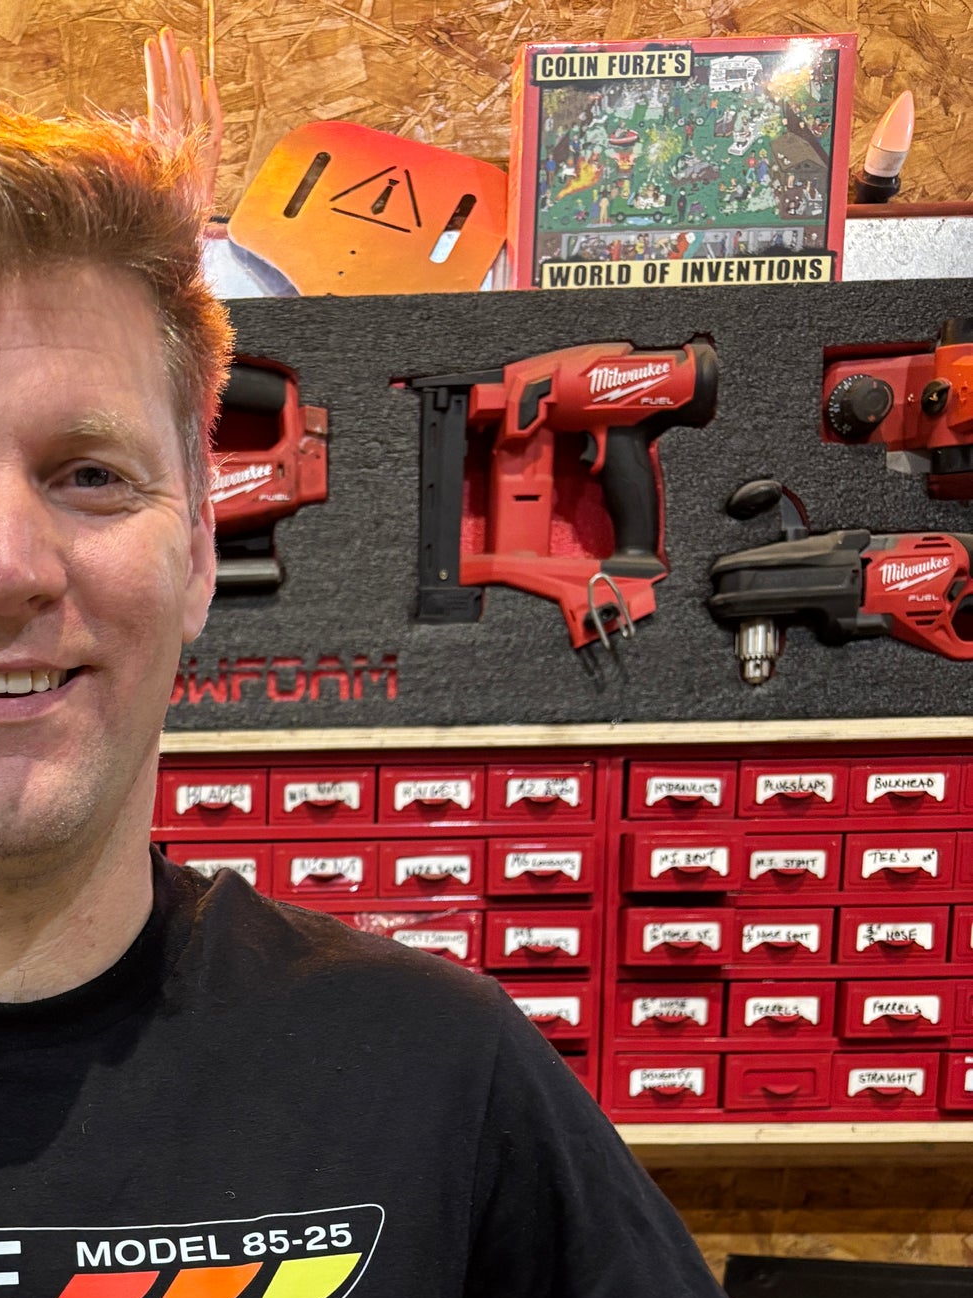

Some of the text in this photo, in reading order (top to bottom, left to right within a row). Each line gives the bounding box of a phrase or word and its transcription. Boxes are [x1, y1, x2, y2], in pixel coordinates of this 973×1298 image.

[542, 53, 686, 78] COLIN FURZE'S
[549, 259, 823, 287] WORLD OF INVENTIONS
[587, 363, 670, 394] Milwaukee
[640, 396, 674, 405] FUEL
[879, 557, 950, 585] Milwaukee
[908, 594, 940, 602] FUEL
[874, 777, 935, 790] BULKHEAD
[76, 1222, 353, 1268] MODEL 85-25
